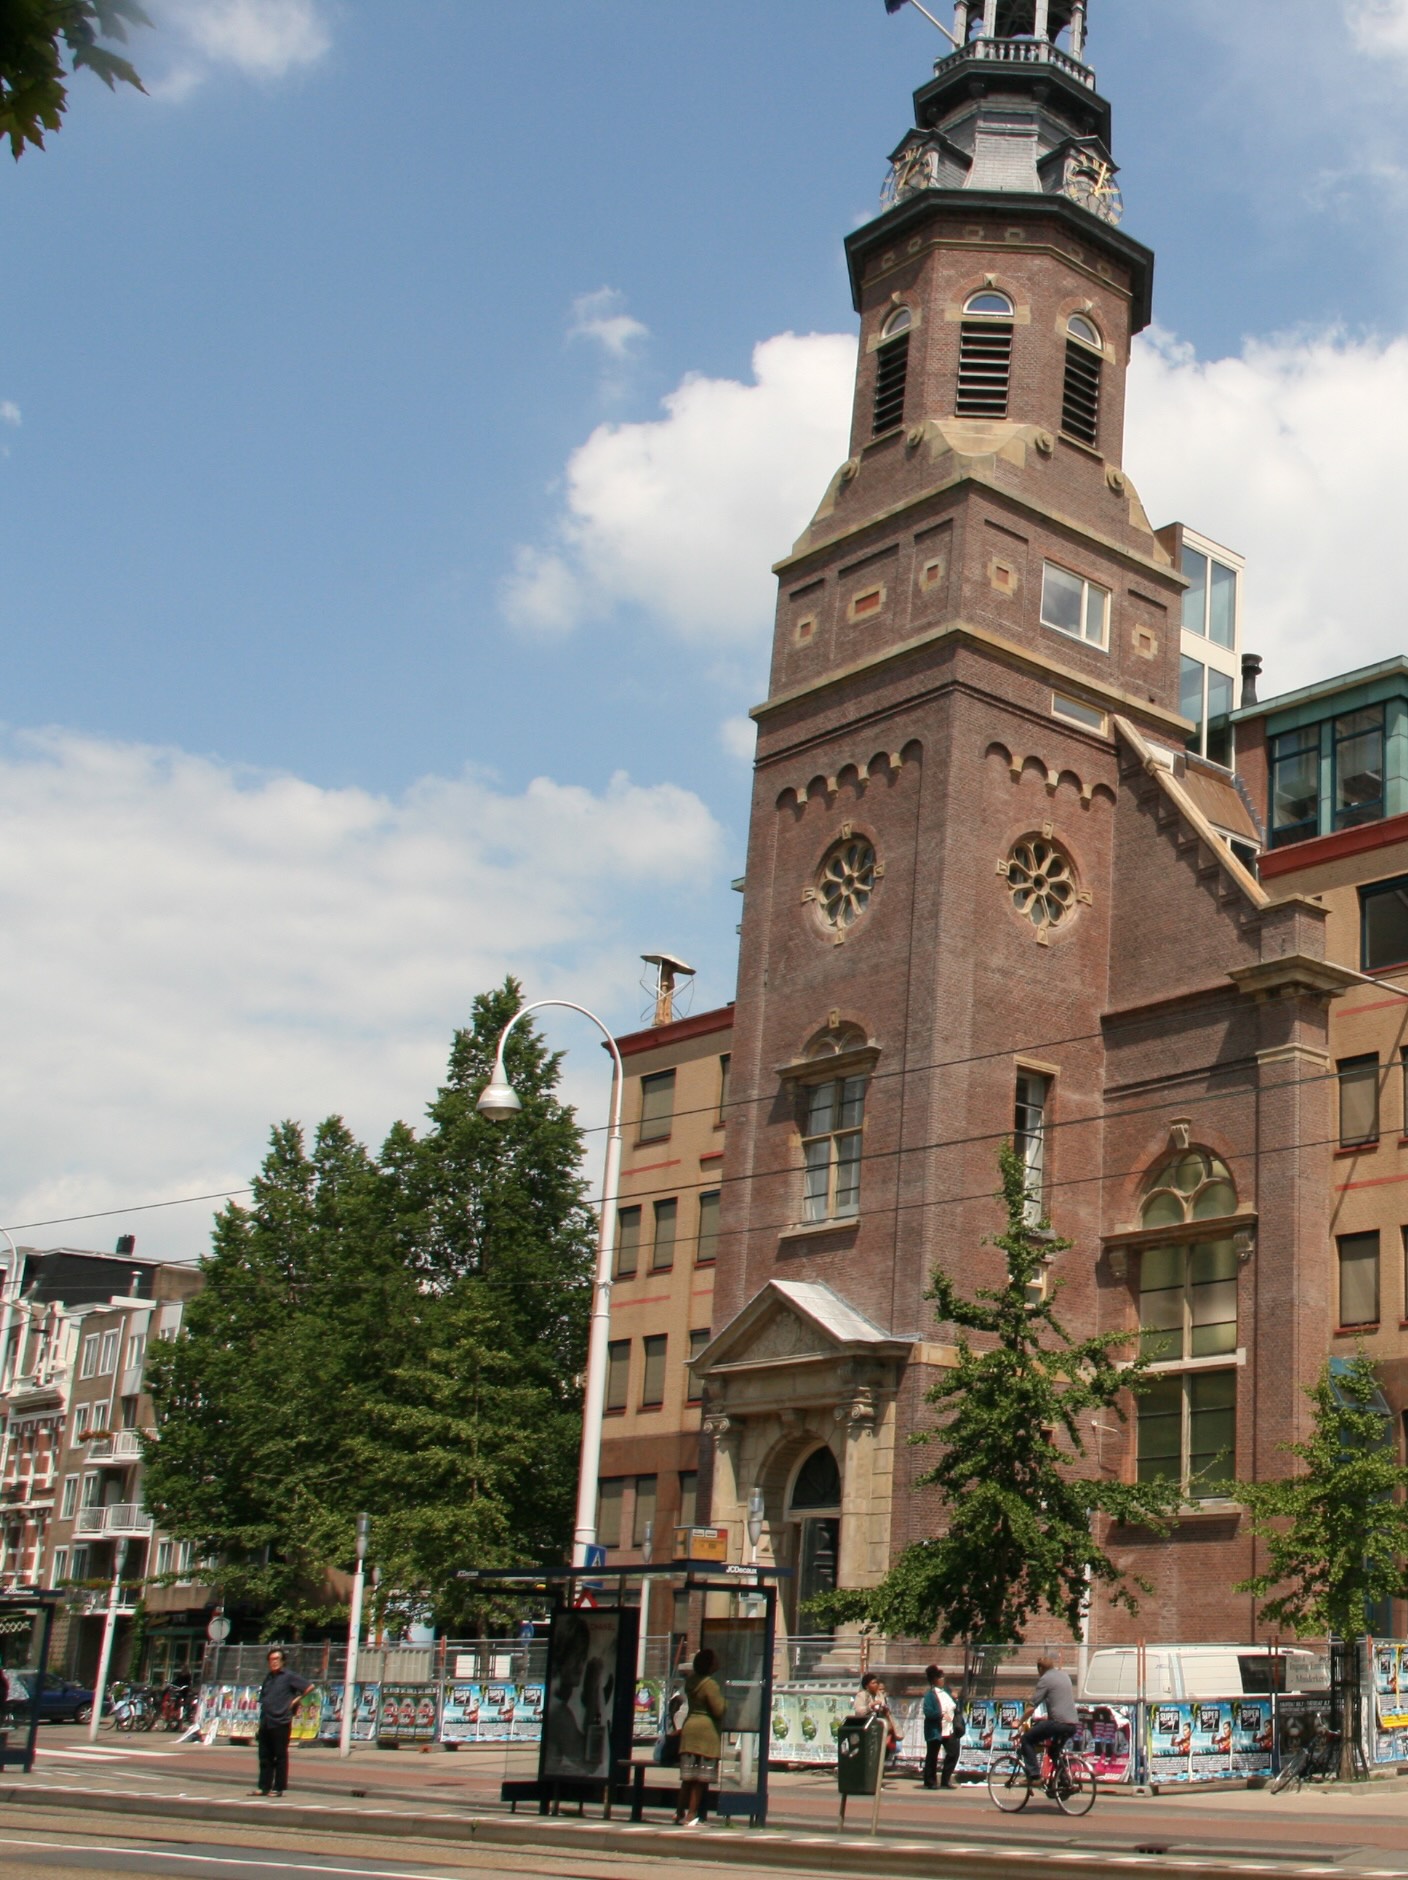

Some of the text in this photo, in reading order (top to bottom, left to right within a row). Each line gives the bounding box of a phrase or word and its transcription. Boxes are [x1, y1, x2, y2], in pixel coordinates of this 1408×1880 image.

[726, 1565, 758, 1575] JCDecaux
[1160, 1711, 1179, 1721] SUPER
[1202, 1710, 1219, 1720] SUPER
[1242, 1708, 1260, 1718] SUPER
